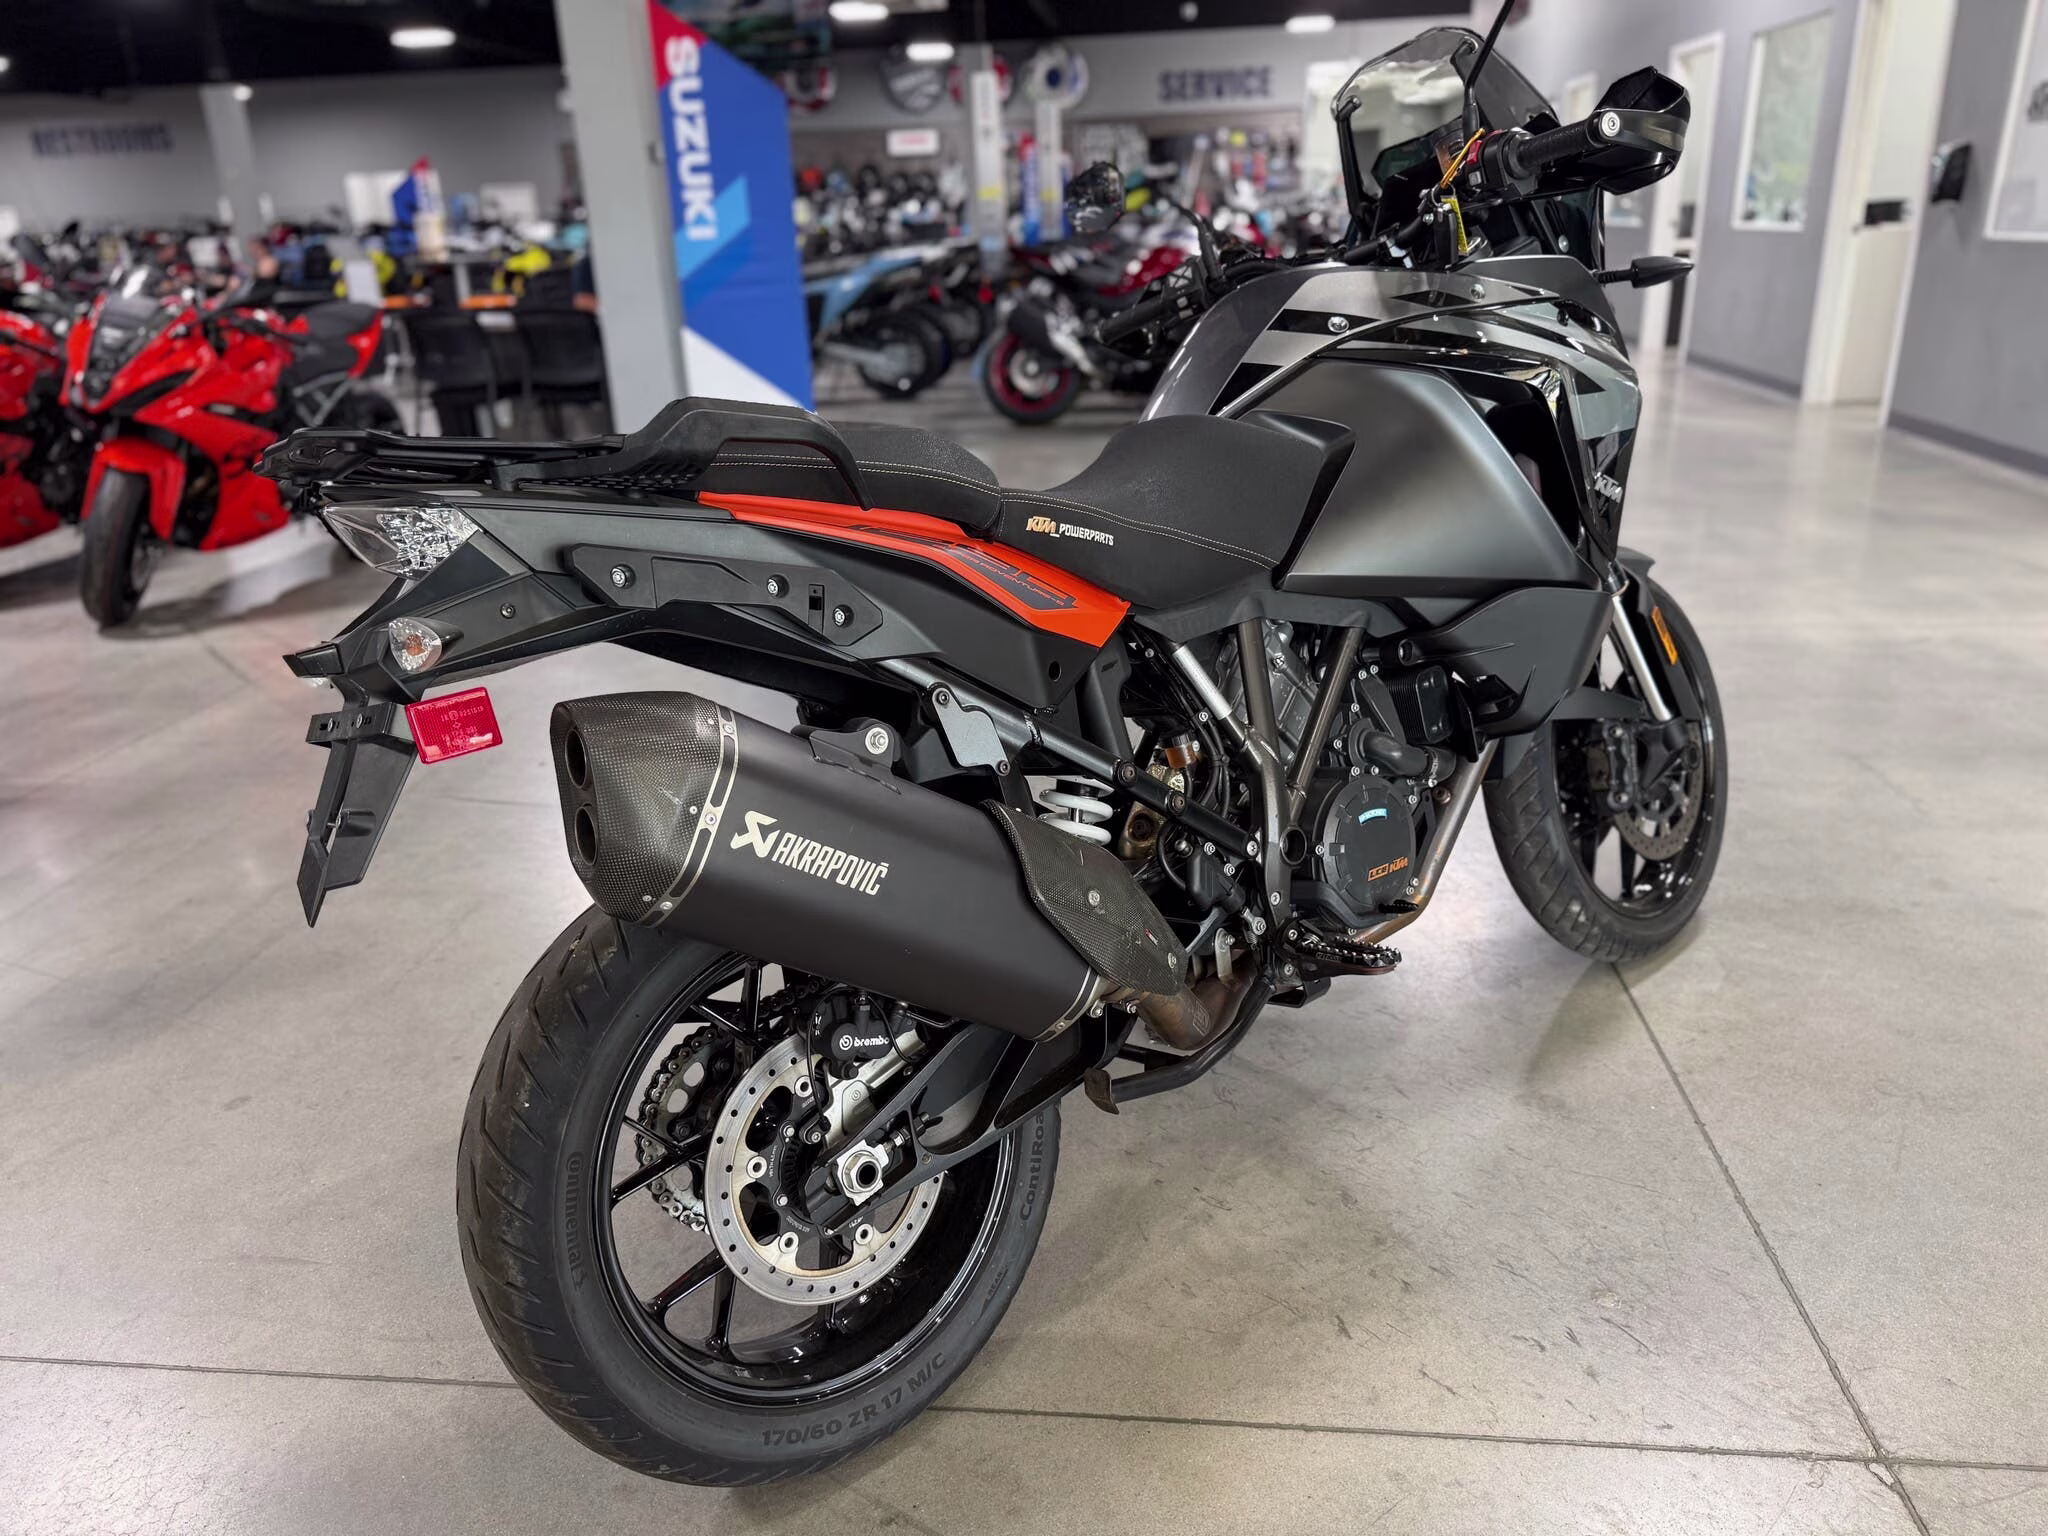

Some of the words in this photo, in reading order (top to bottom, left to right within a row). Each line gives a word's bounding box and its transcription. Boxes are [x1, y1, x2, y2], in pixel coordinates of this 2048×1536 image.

[1160, 66, 1272, 103] SERVICE
[664, 35, 718, 240] SUZUKI
[1594, 474, 1622, 503] KTM
[771, 832, 889, 896] AKRAPOVIČ
[854, 1035, 890, 1047] brembo
[762, 1419, 842, 1447] 170/60
[848, 1404, 879, 1428] ZR
[881, 1390, 901, 1410] 17
[906, 1352, 946, 1393] M/C
